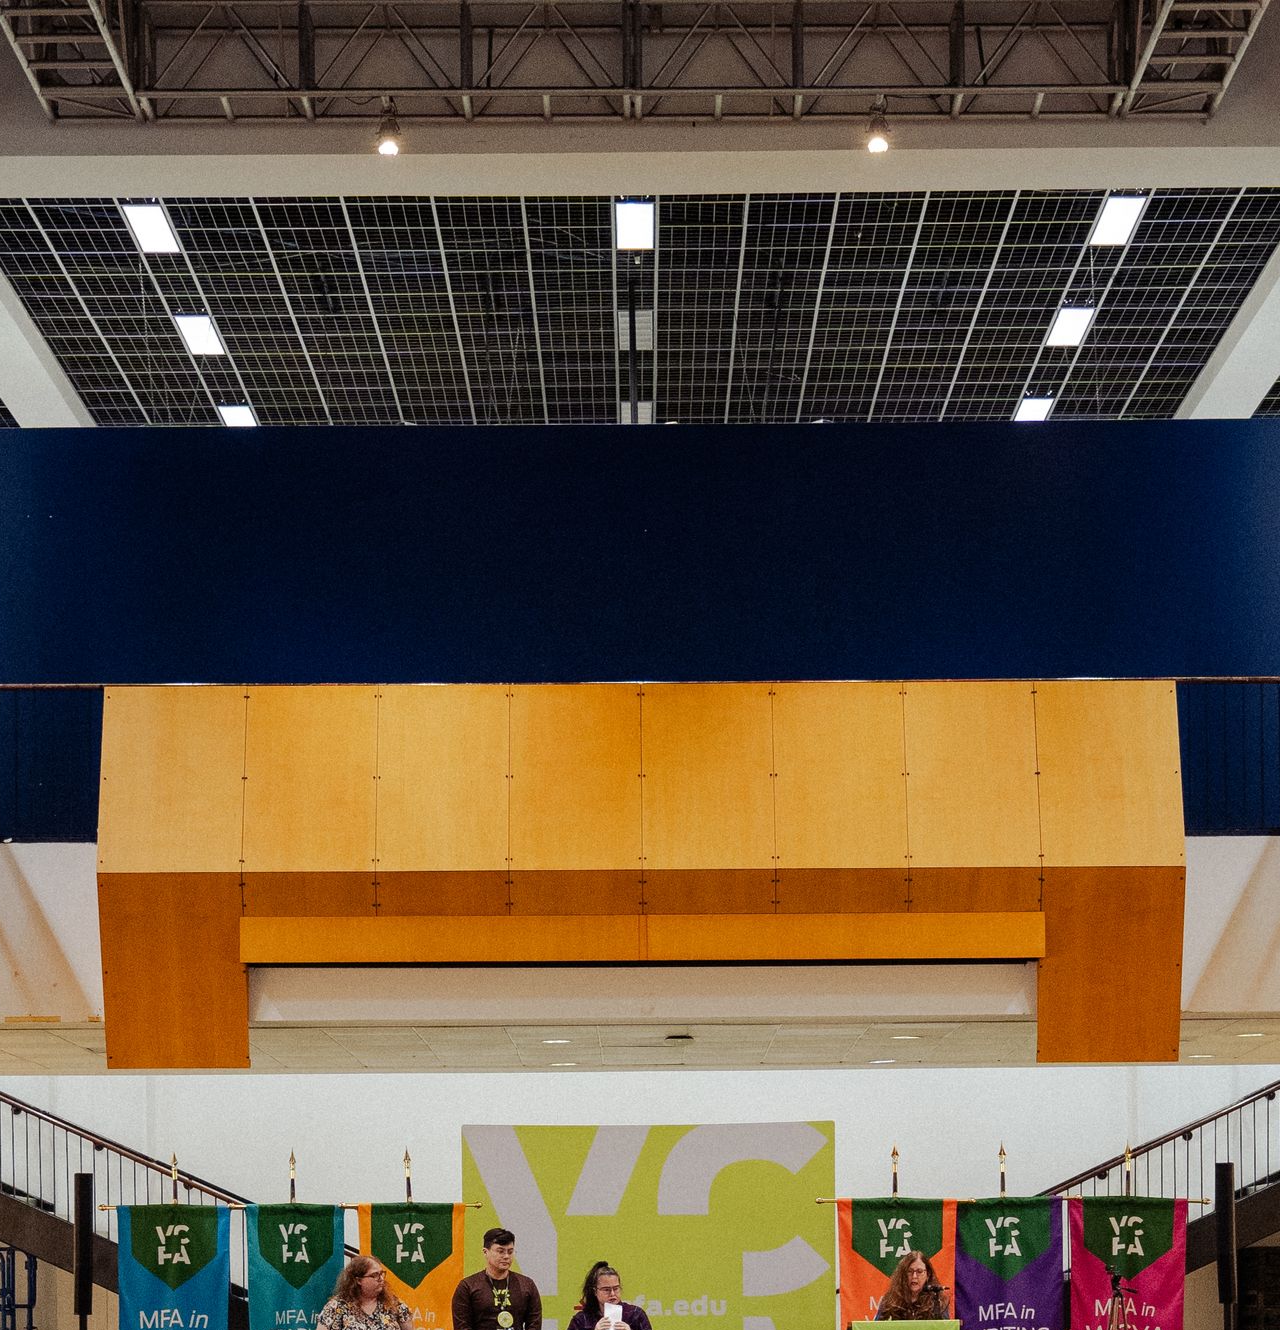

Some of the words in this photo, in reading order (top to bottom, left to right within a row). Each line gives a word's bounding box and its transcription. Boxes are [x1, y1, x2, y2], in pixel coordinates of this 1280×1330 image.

[634, 1294, 727, 1316] fa.edu
[978, 1302, 1018, 1321] MFA
[1020, 1304, 1035, 1319] in
[1095, 1297, 1137, 1317] MA
[1141, 1302, 1156, 1317] in
[139, 1308, 184, 1329] MFA
[188, 1310, 209, 1329] in
[275, 1309, 308, 1325] MFA
